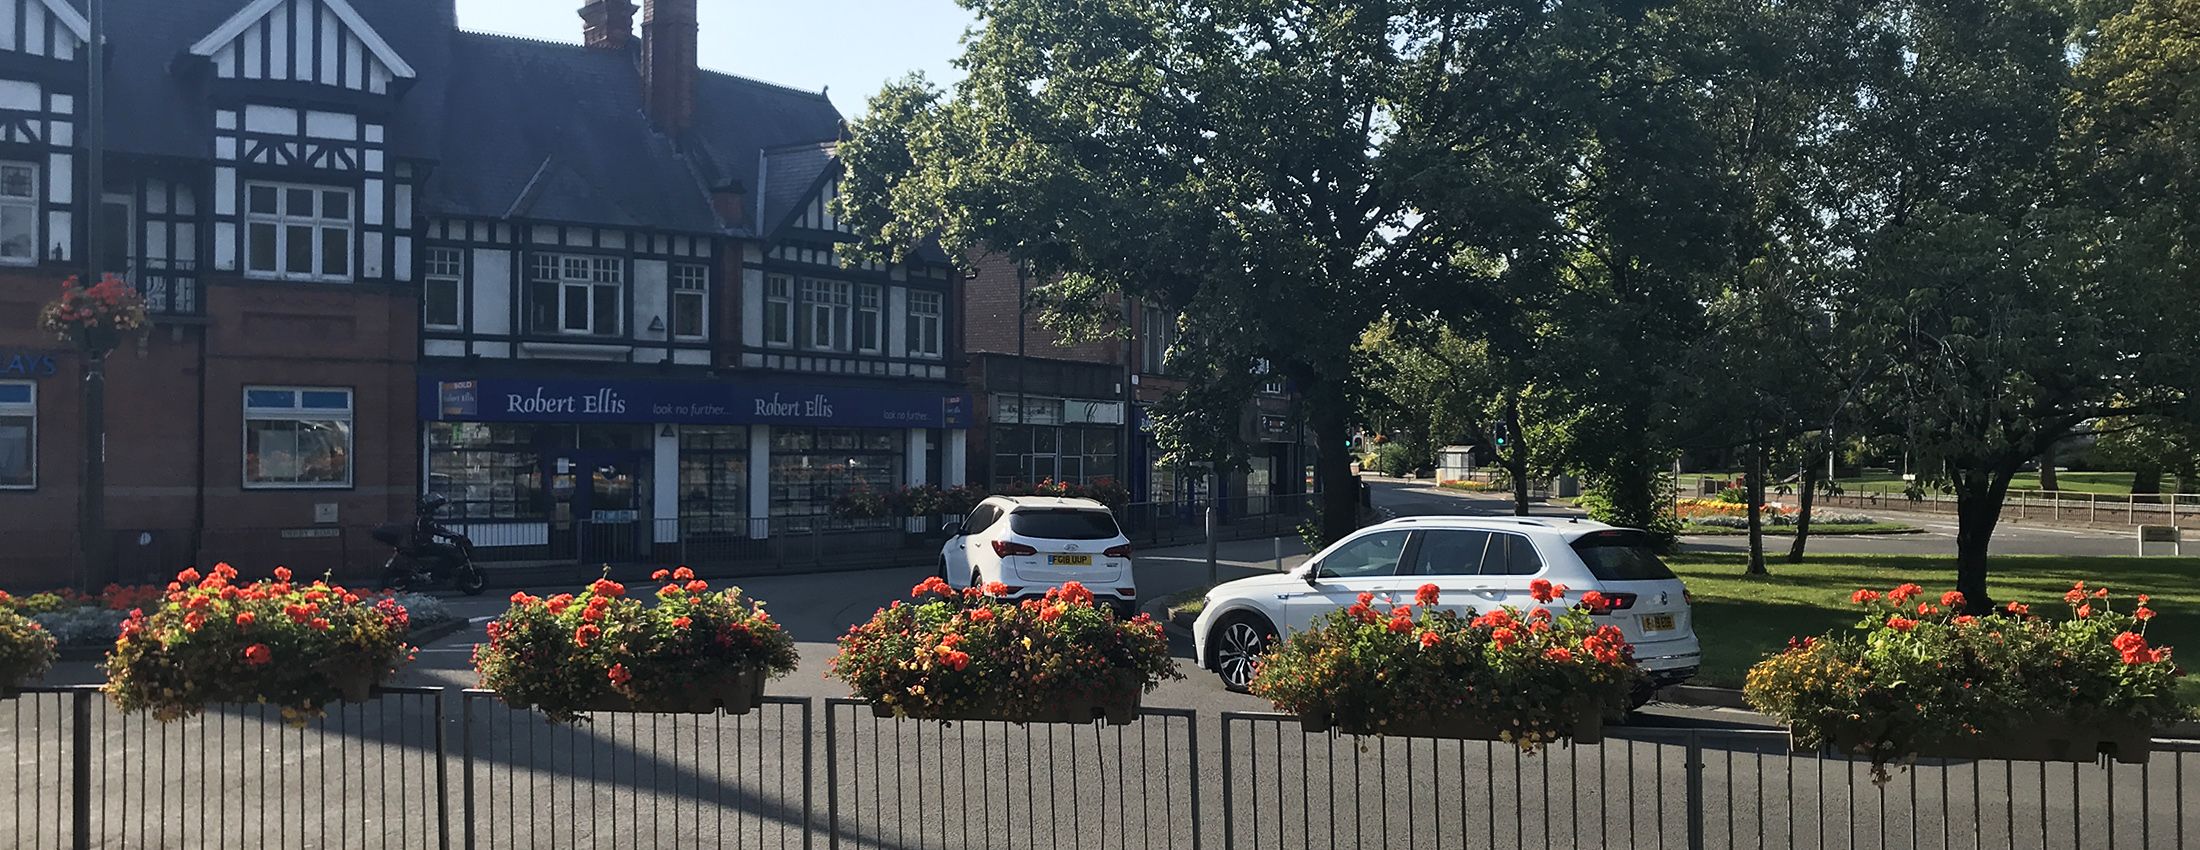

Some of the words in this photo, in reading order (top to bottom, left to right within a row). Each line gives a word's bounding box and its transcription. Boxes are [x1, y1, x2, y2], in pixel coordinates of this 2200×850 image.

[454, 381, 473, 389] SOLD
[507, 387, 576, 413] Robert
[583, 388, 626, 413] Ellis
[754, 392, 800, 417] Robert
[805, 394, 833, 418] Ellis
[653, 403, 673, 414] look
[676, 406, 689, 415] no
[1072, 555, 1087, 564] UUP
